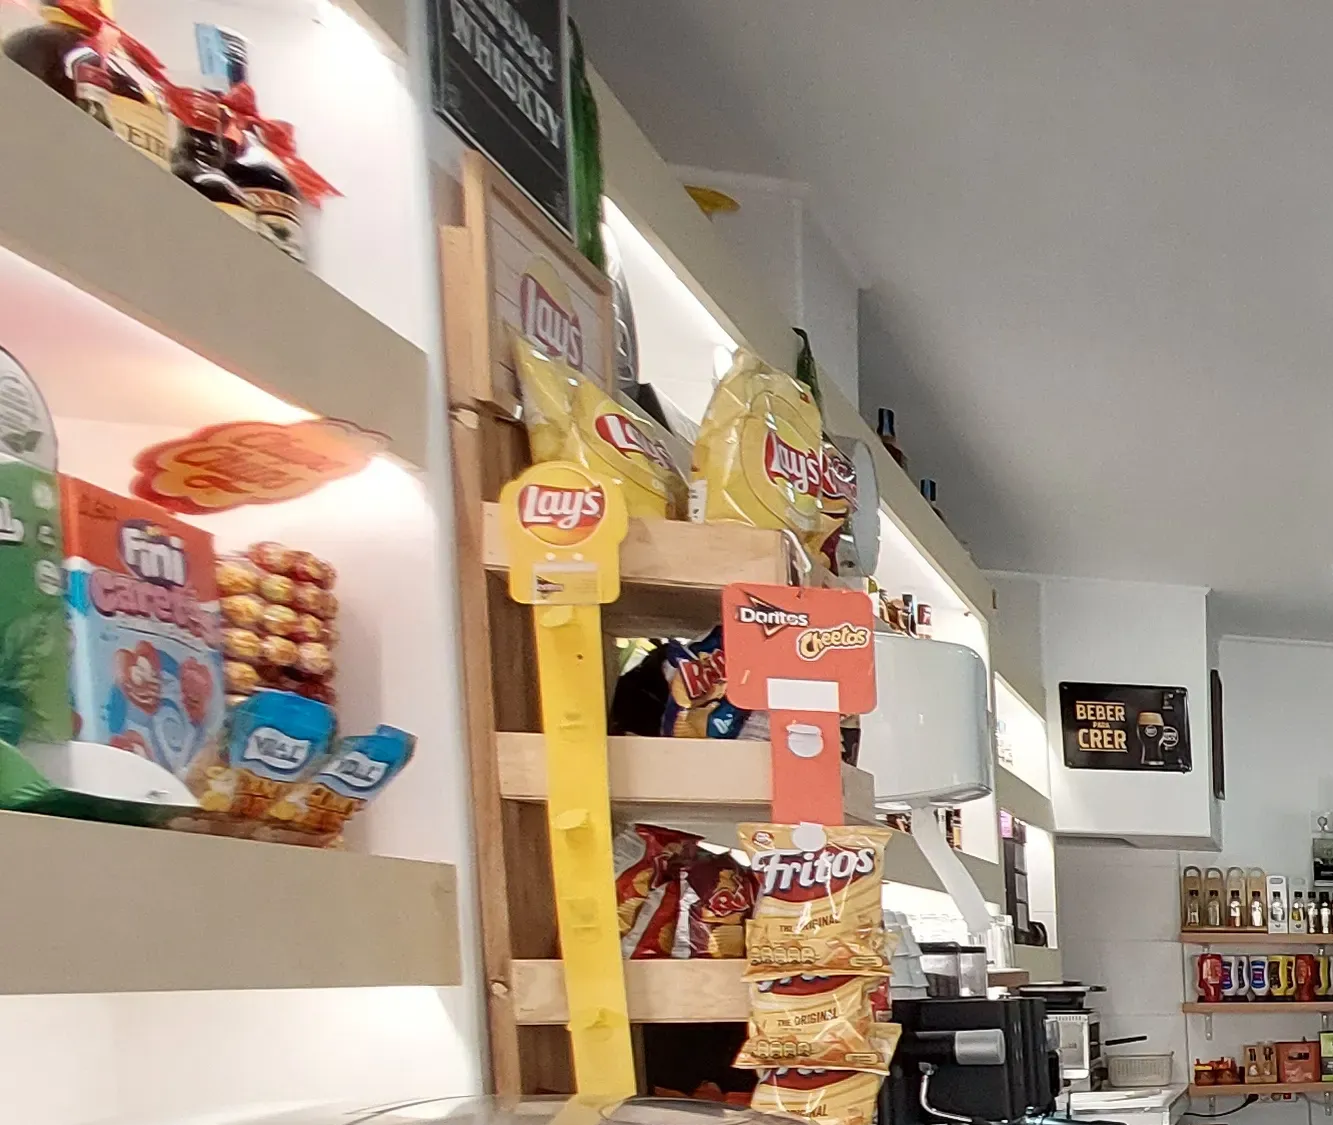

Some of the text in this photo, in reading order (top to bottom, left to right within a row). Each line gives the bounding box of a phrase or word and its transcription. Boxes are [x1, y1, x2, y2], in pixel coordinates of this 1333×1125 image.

[450, 0, 566, 149] WHISKEY
[522, 484, 602, 530] Lay's
[739, 607, 809, 627] Doritos
[798, 626, 869, 659] Cheetos
[1076, 704, 1126, 722] BEBER
[1078, 728, 1127, 750] CRER
[751, 847, 875, 896] Fritos
